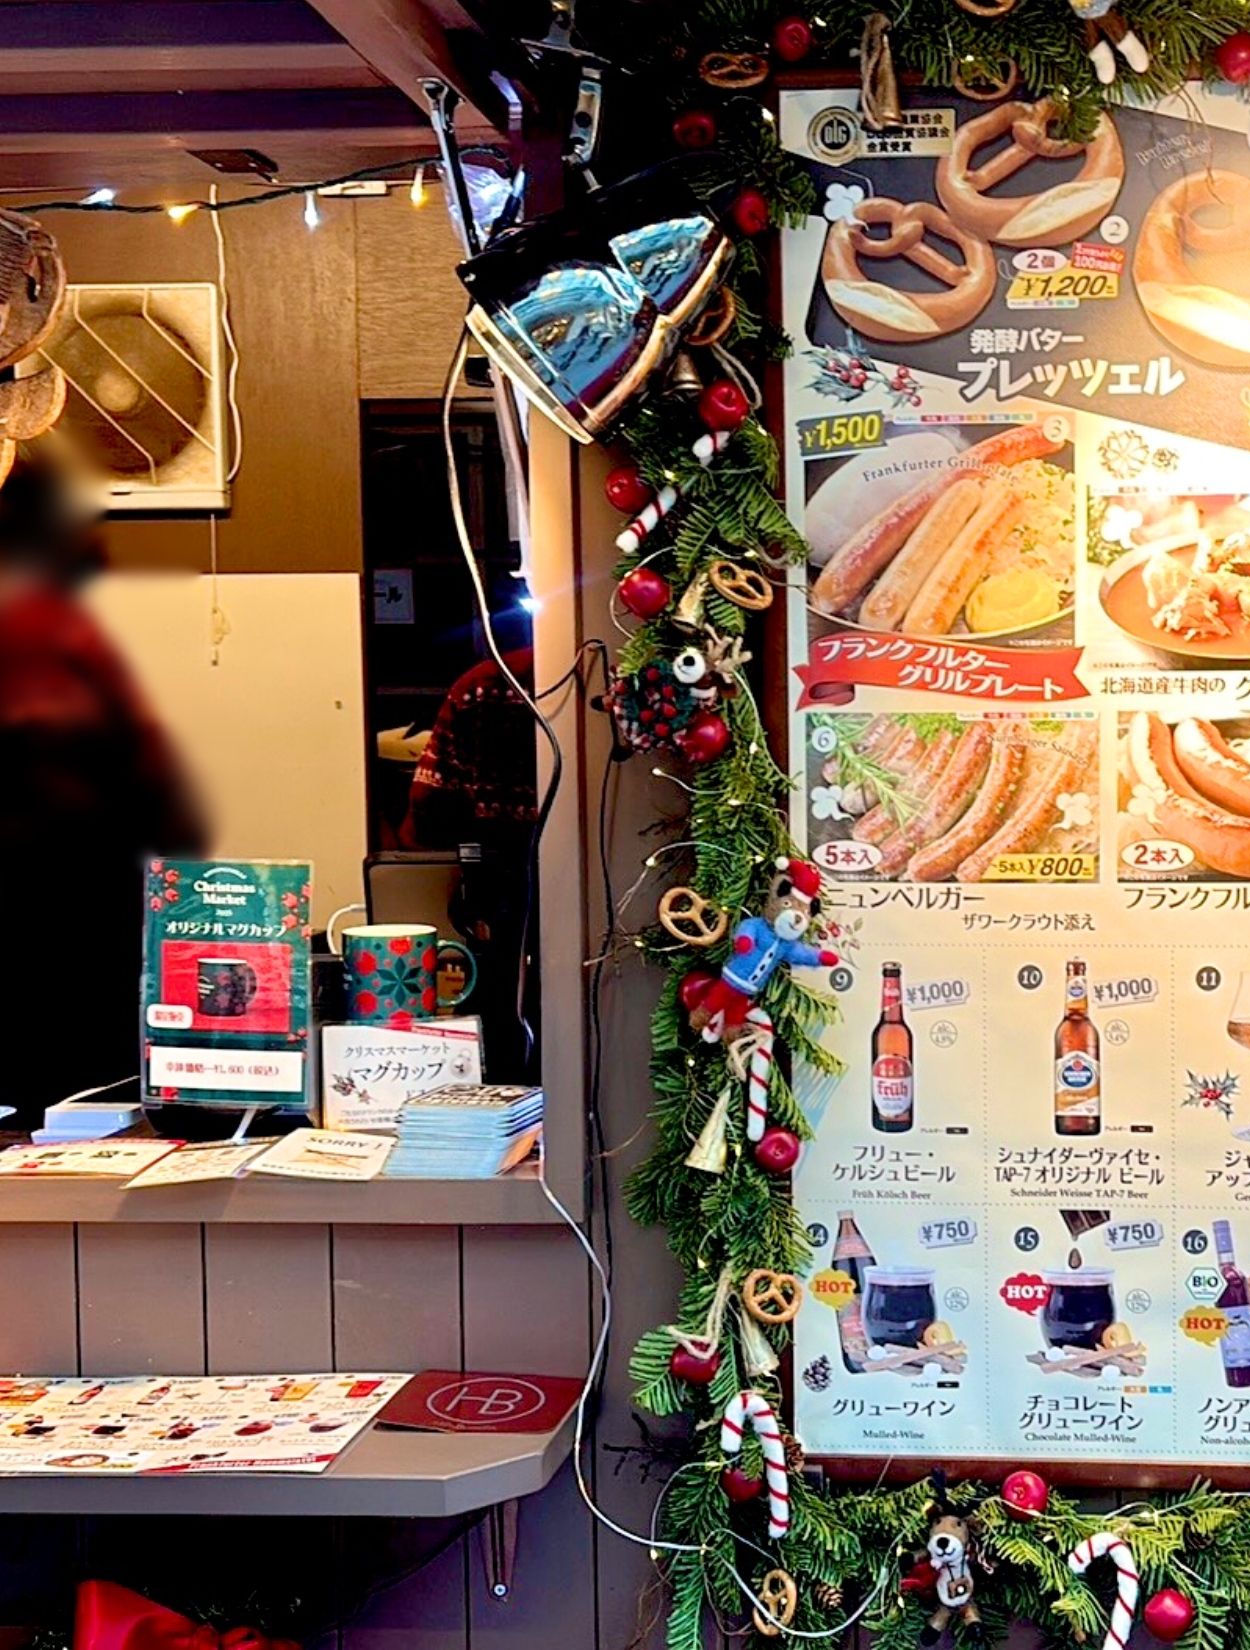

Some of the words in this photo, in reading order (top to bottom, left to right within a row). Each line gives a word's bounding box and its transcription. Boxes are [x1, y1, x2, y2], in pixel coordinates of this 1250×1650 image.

[1108, 222, 1121, 236] 2
[1021, 275, 1108, 297] ¥1,200
[970, 329, 1085, 353] 発酵バター
[957, 357, 1186, 400] プレッツェル
[803, 413, 881, 450] ¥1,500
[1049, 419, 1062, 436] 3
[862, 457, 943, 482] Frankfurter
[817, 638, 1010, 670] フランクフルター
[897, 665, 1064, 699] グリルプレート
[1100, 677, 1226, 695] 北海道産牛肉の
[818, 732, 830, 747] 6
[824, 845, 874, 865] 5本入
[1133, 844, 1185, 866] 2本入
[1027, 857, 1083, 876] ¥800
[193, 880, 256, 894] Christmas
[202, 893, 247, 906] Market
[826, 887, 985, 911] ニュンベルガー
[962, 912, 1096, 931] ザワークラウト添え
[834, 972, 847, 988] 9
[1021, 970, 1040, 986] 10
[1201, 972, 1216, 986] 11
[907, 980, 963, 1003] ¥1,000
[1094, 977, 1152, 1001] ¥1,000
[345, 1040, 450, 1059] クリスマスマーケット
[353, 1058, 447, 1083] マグカップ
[307, 1135, 367, 1149] SORRY
[998, 1148, 1161, 1165] シュナイダーヴァイセ・
[833, 1164, 956, 1183] ケルシュビール
[994, 1167, 1030, 1183] TAP-7
[1036, 1166, 1116, 1184] オリジナル
[1120, 1166, 1164, 1185] ビール
[852, 1188, 875, 1199] Früh
[877, 1188, 907, 1199] Kölsch
[910, 1189, 931, 1199] Beer
[1010, 1187, 1056, 1198] Schneider
[1059, 1188, 1093, 1198] Weisse
[1096, 1188, 1125, 1198] TAP-7
[1127, 1189, 1149, 1199] Beer
[922, 1220, 970, 1242] ¥750
[1018, 1231, 1037, 1247] 15
[1106, 1222, 1156, 1244] ¥750
[1185, 1234, 1204, 1249] 16
[814, 1280, 851, 1294] HOT
[1006, 1285, 1047, 1300] HOT
[1186, 1318, 1224, 1330] HOT
[832, 1399, 956, 1417] グリューワイン
[1027, 1395, 1132, 1412] チョコレート
[1020, 1412, 1143, 1431] グリューワイン
[862, 1429, 925, 1440] Mulled-Wine
[1024, 1432, 1071, 1443] Chocolate
[1073, 1433, 1137, 1444] Mulled-Wine
